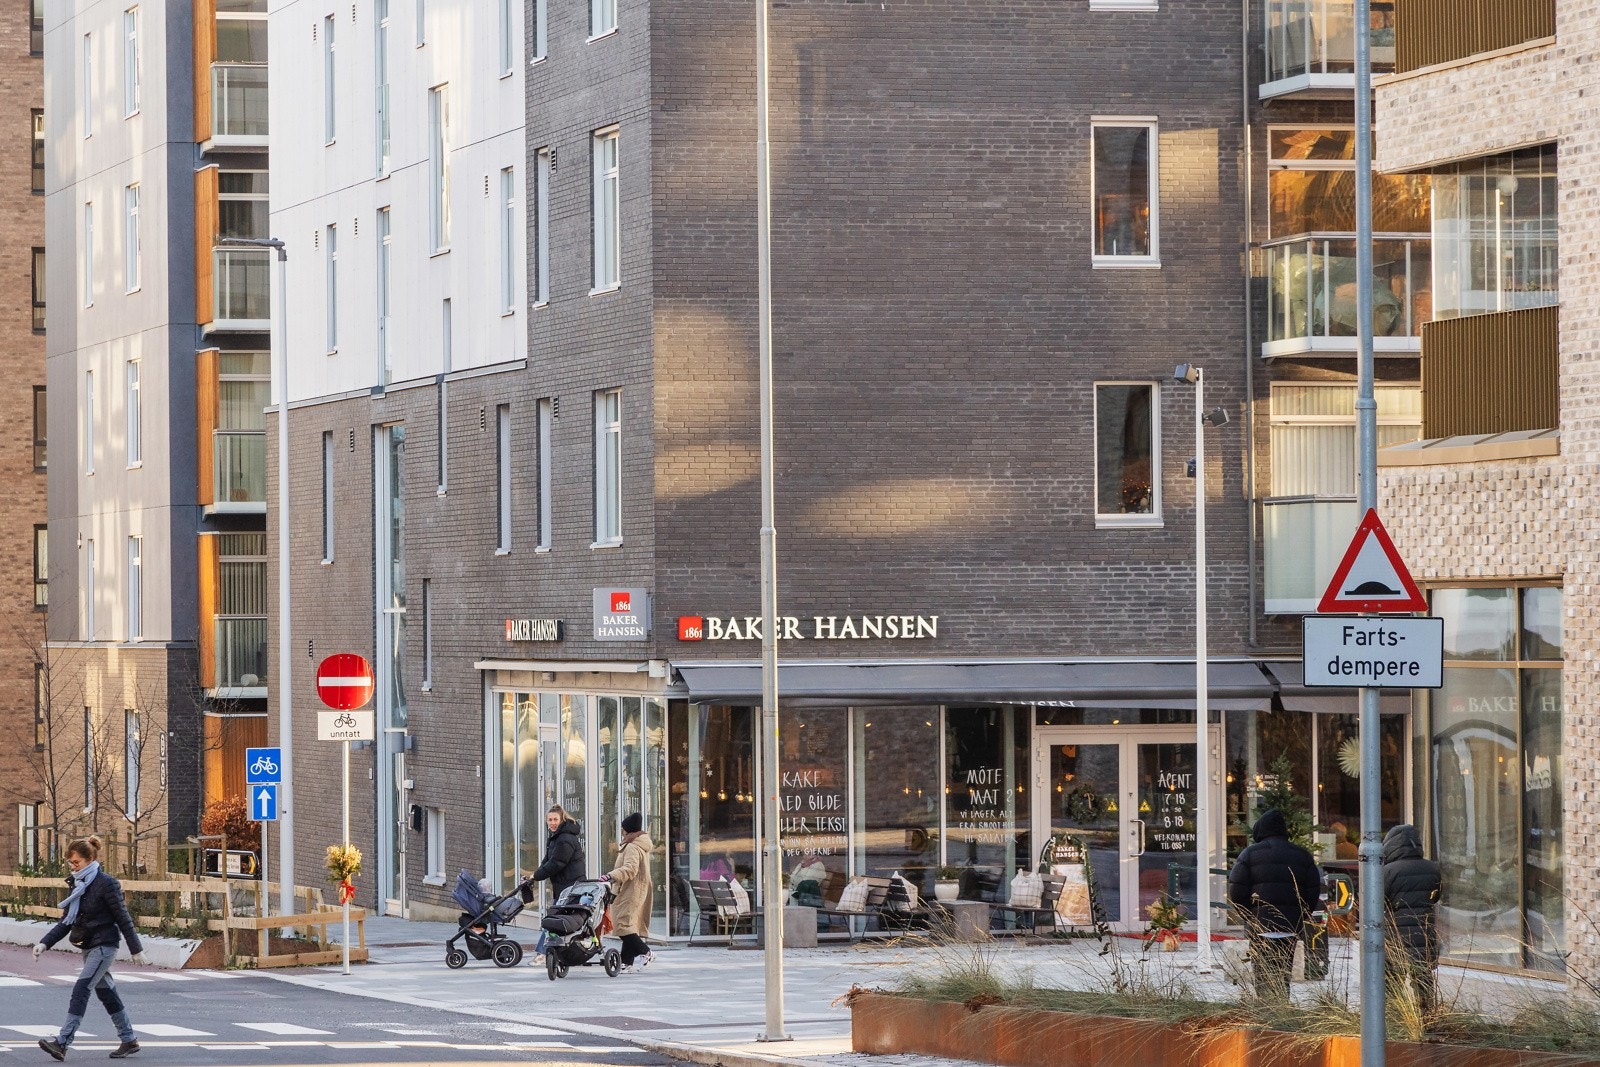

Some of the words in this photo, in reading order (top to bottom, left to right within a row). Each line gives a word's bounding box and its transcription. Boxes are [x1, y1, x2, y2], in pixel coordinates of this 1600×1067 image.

[615, 601, 631, 611] 1861
[603, 615, 639, 625] BAKER
[685, 627, 702, 638] 1861
[813, 615, 939, 639] HANSEN
[531, 620, 558, 641] HANSEN
[598, 627, 644, 636] HANSEN
[1343, 625, 1406, 646] Farts-
[1327, 655, 1420, 680] dempere
[782, 770, 821, 788] KAKE
[779, 795, 802, 811] ED
[808, 792, 841, 811] BILDE
[970, 788, 1000, 805] MAT
[970, 809, 996, 819] LAGER
[780, 816, 811, 834] LLER
[814, 816, 846, 832] TEKST
[1153, 833, 1196, 842] VELKOMMEN
